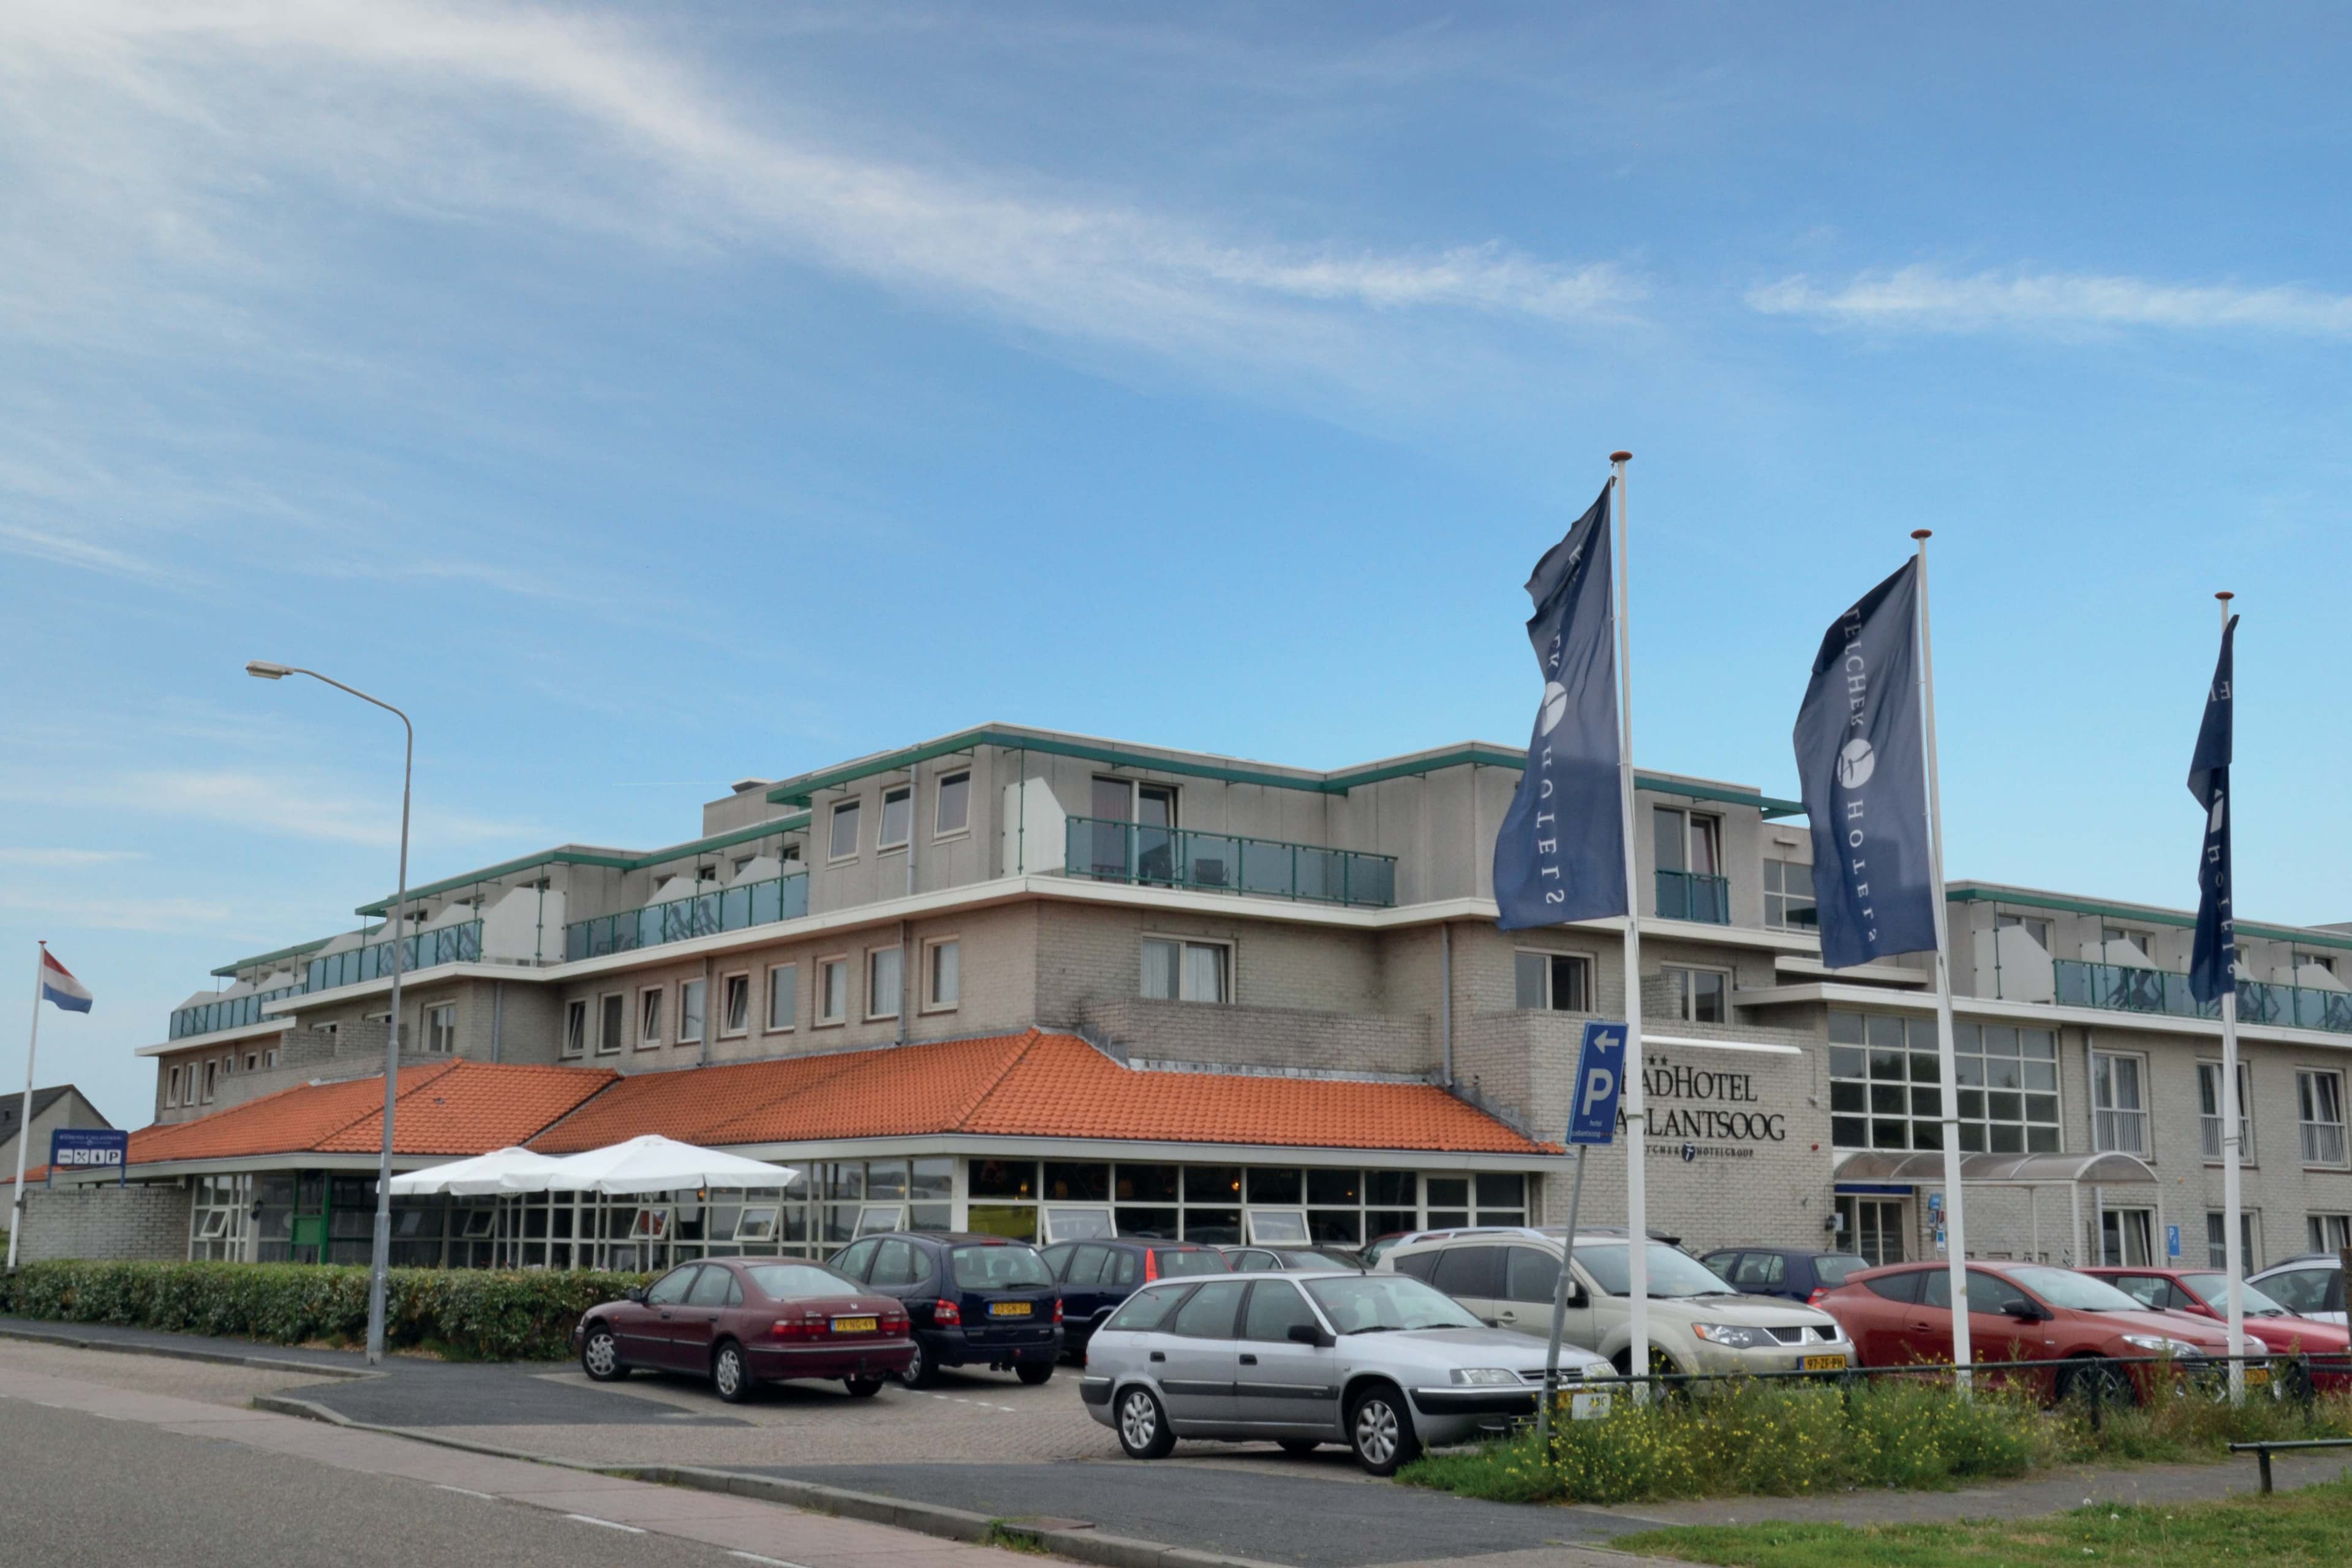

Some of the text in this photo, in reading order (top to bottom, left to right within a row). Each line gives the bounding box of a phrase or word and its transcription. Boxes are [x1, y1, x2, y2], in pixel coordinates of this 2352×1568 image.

[1582, 1068, 1614, 1116] P
[1615, 1106, 1785, 1141] ALANTSOOG
[2169, 1227, 2175, 1240] P
